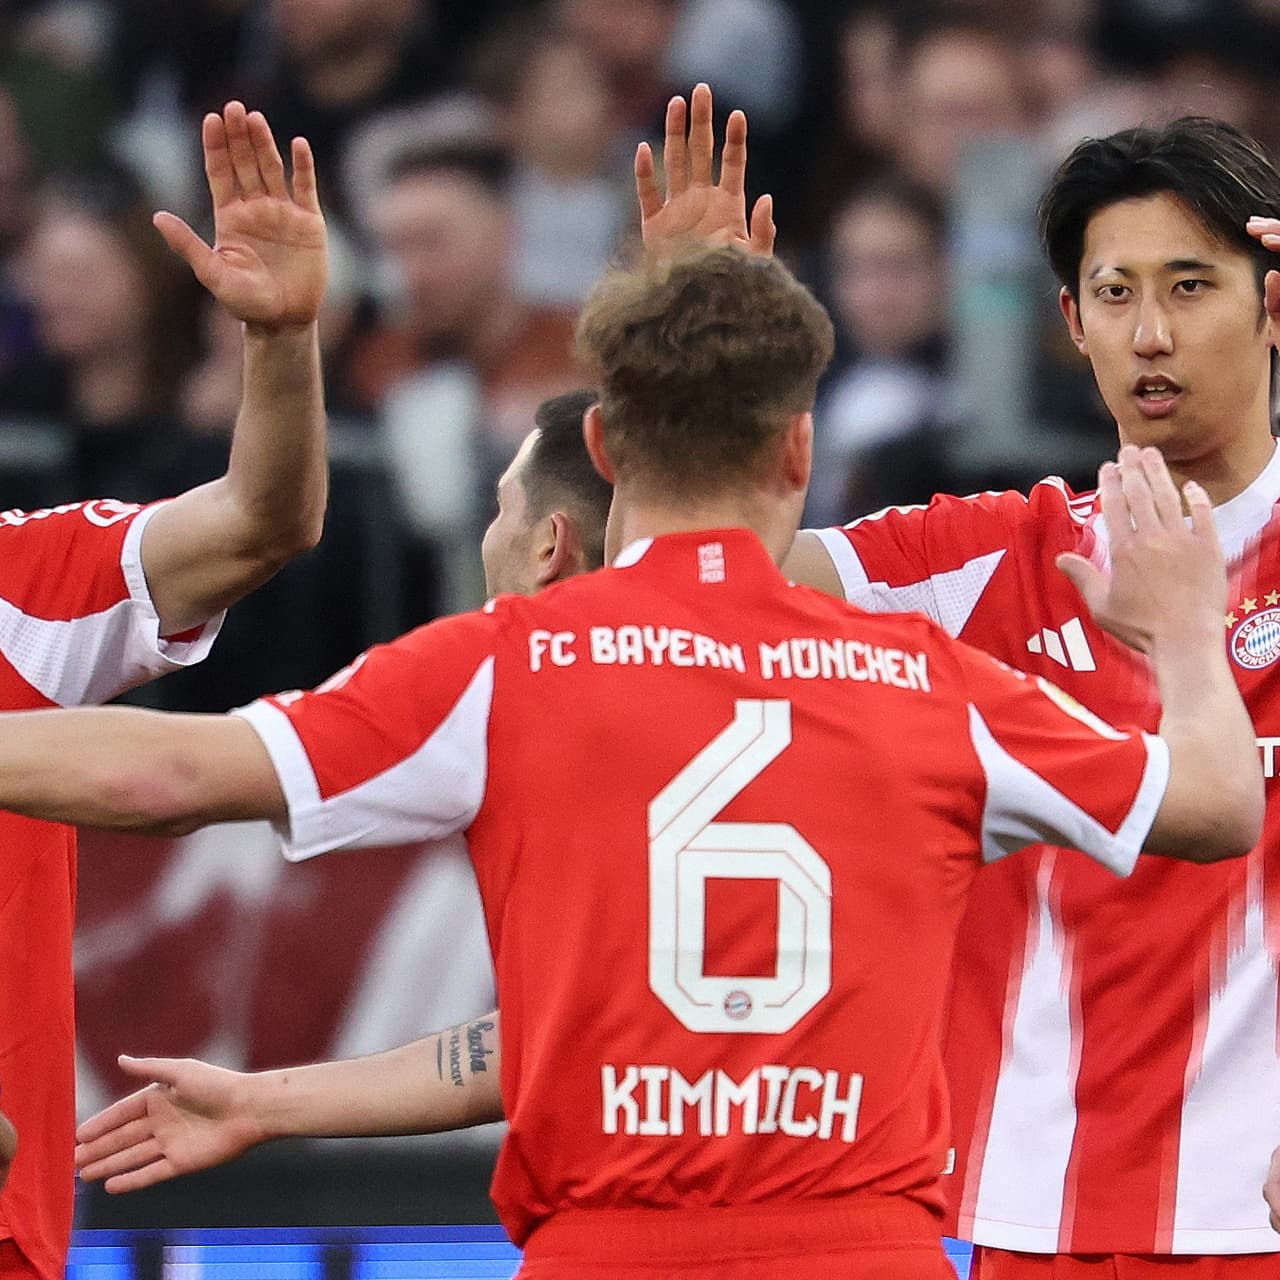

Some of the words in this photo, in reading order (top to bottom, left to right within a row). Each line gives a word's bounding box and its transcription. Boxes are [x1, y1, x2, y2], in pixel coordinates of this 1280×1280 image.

[529, 630, 577, 672] FC
[589, 625, 747, 673] BAYERN
[759, 637, 931, 692] MÜNCHEN
[648, 698, 832, 1034] 6
[601, 1064, 863, 1142] KIMMICH
